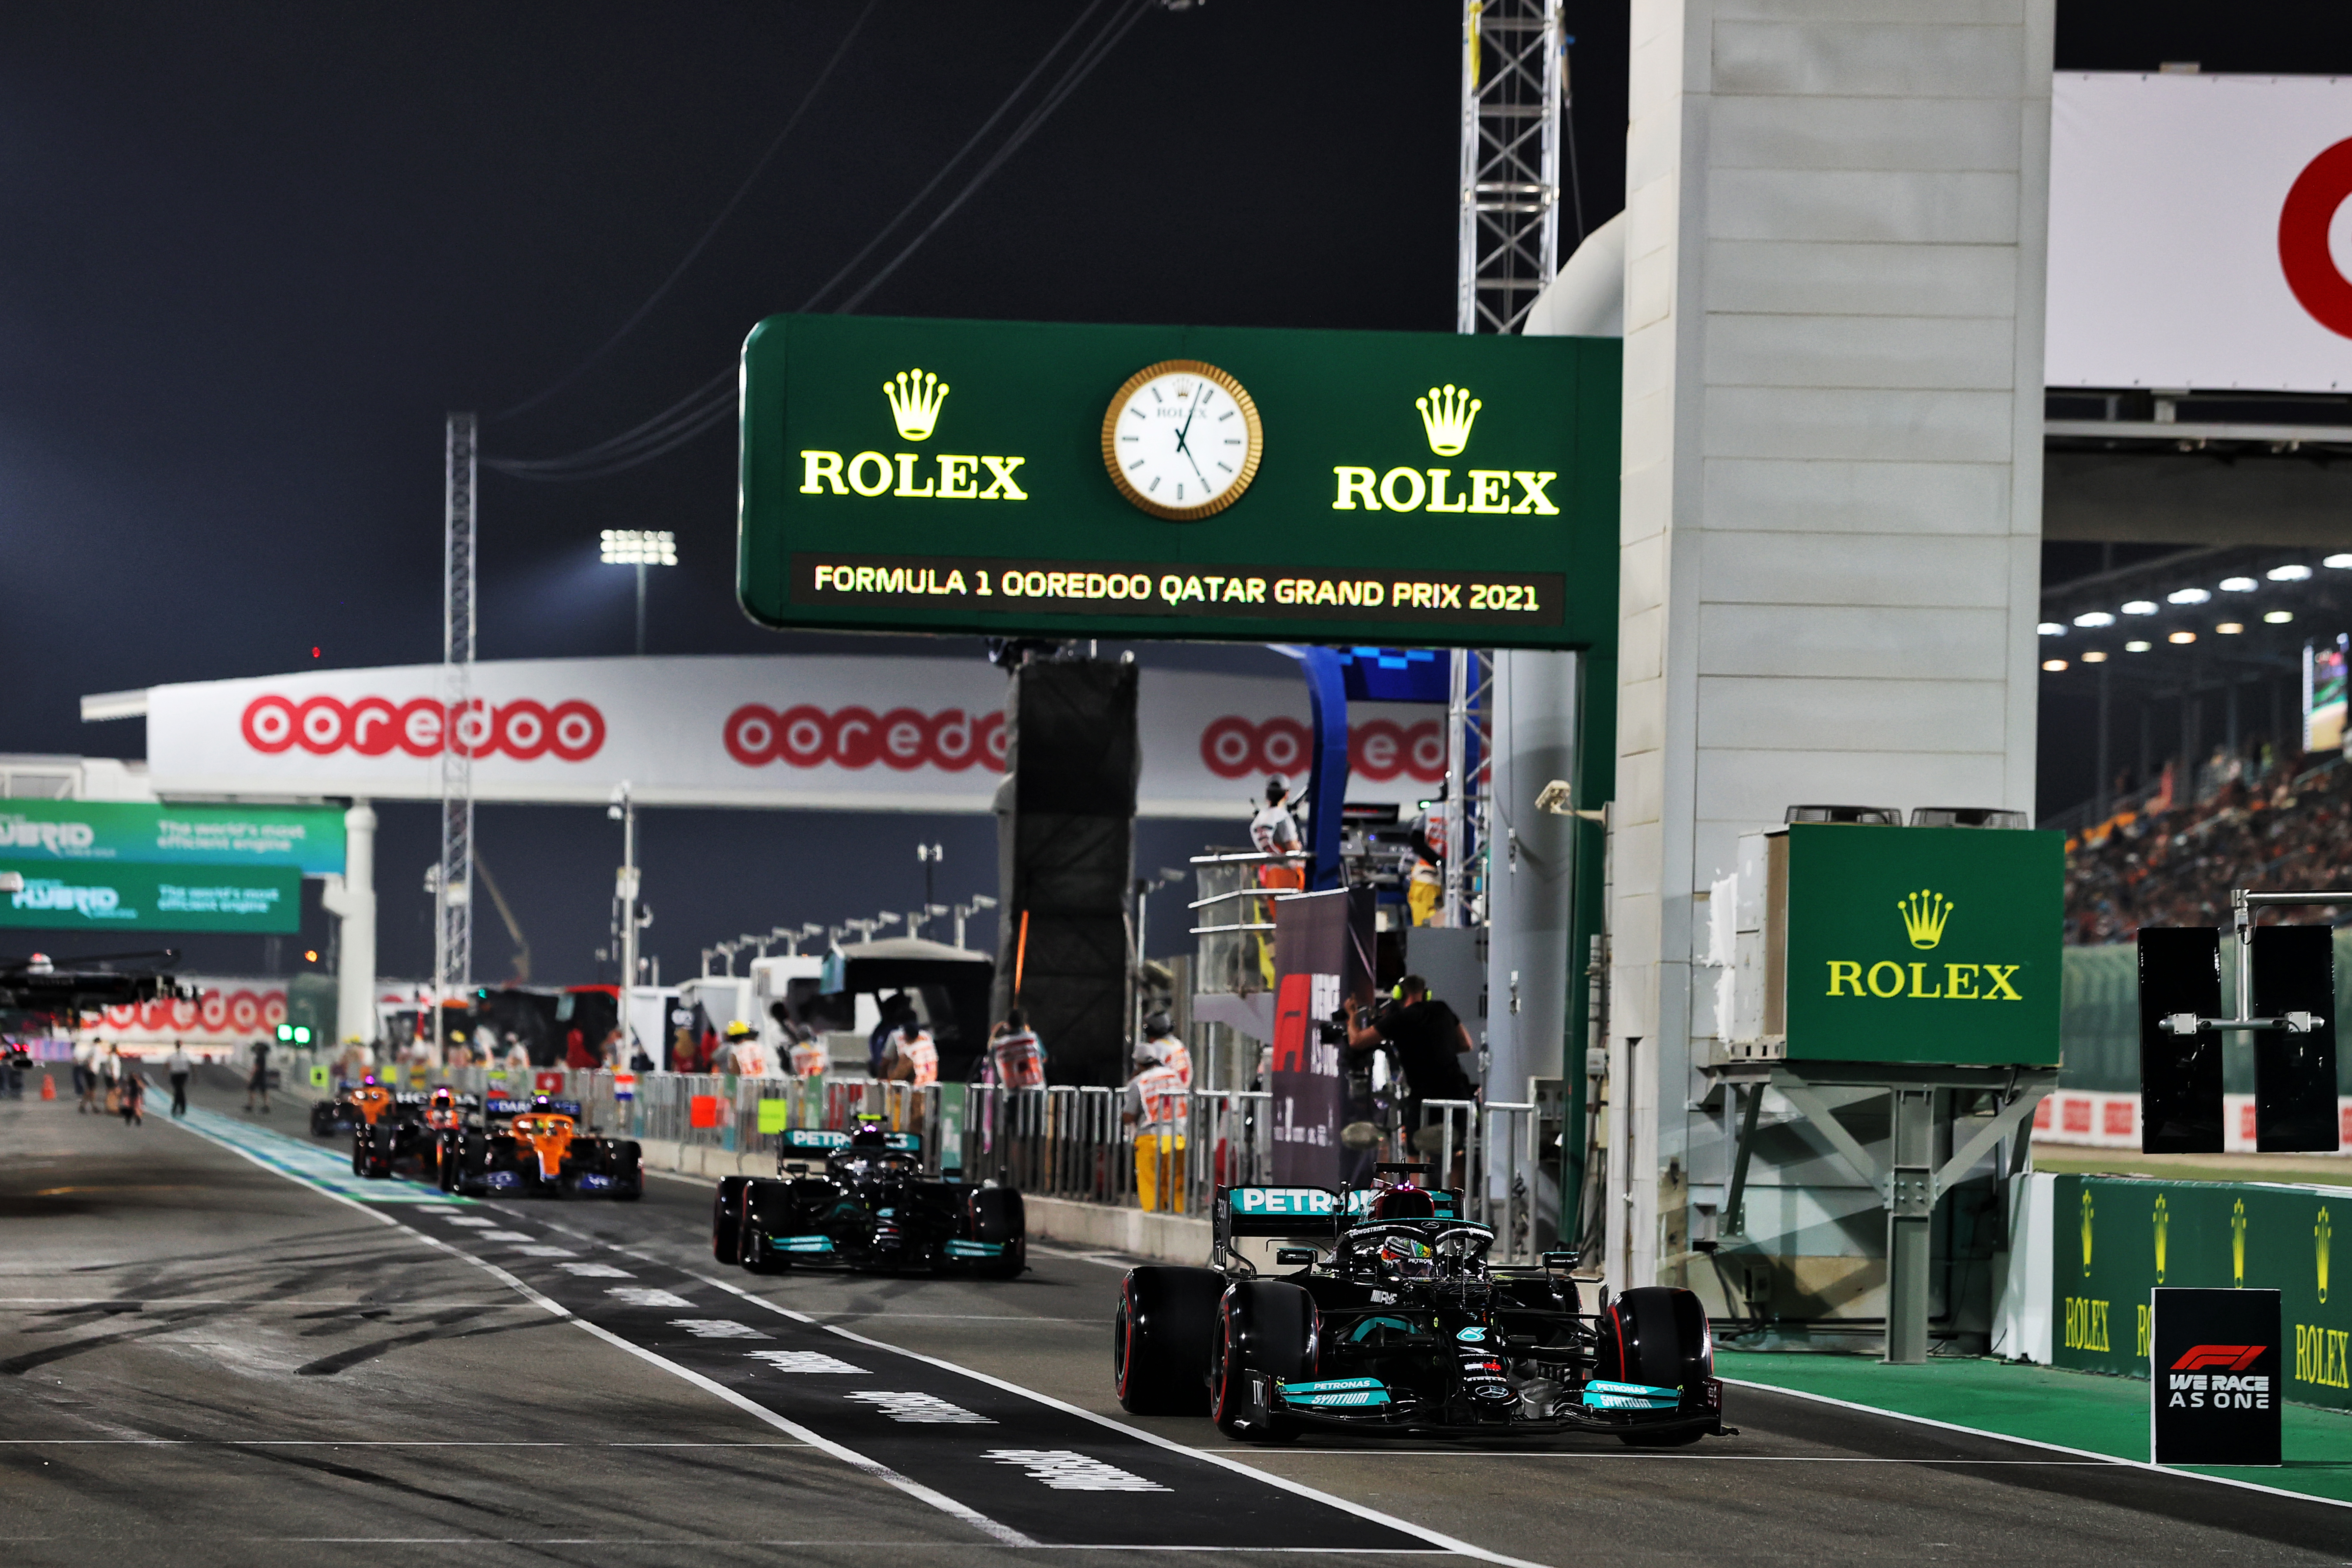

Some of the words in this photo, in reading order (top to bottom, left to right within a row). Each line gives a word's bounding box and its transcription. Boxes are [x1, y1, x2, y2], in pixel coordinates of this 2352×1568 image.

[800, 450, 1028, 501] ROLEX
[1332, 466, 1560, 515] ROLEX
[815, 565, 967, 596] FORMULA
[976, 571, 993, 596] 1
[1001, 570, 1153, 600] OOREDOO
[1159, 575, 1266, 606] QATAR
[1274, 578, 1385, 606] GRAND
[1392, 582, 1462, 609] PRIX
[1468, 584, 1540, 611] 2021
[249, 698, 596, 750] ooredoo
[735, 714, 1007, 761] ooredo
[1825, 960, 2023, 1001] ROLEX
[1456, 1326, 1488, 1342] 6
[2064, 1297, 2110, 1353] ROLEX
[2295, 1324, 2349, 1389] ROLEX
[1311, 1392, 1370, 1405] SYNTIUM
[1314, 1380, 1371, 1390] PETRONAS
[1596, 1383, 1648, 1394] PETRONAS
[1599, 1395, 1653, 1408] SYNTIUM
[2168, 1392, 2205, 1408] AS
[2214, 1393, 2269, 1409] ONE
[2169, 1375, 2208, 1390] WE
[2211, 1375, 2269, 1391] RACE
